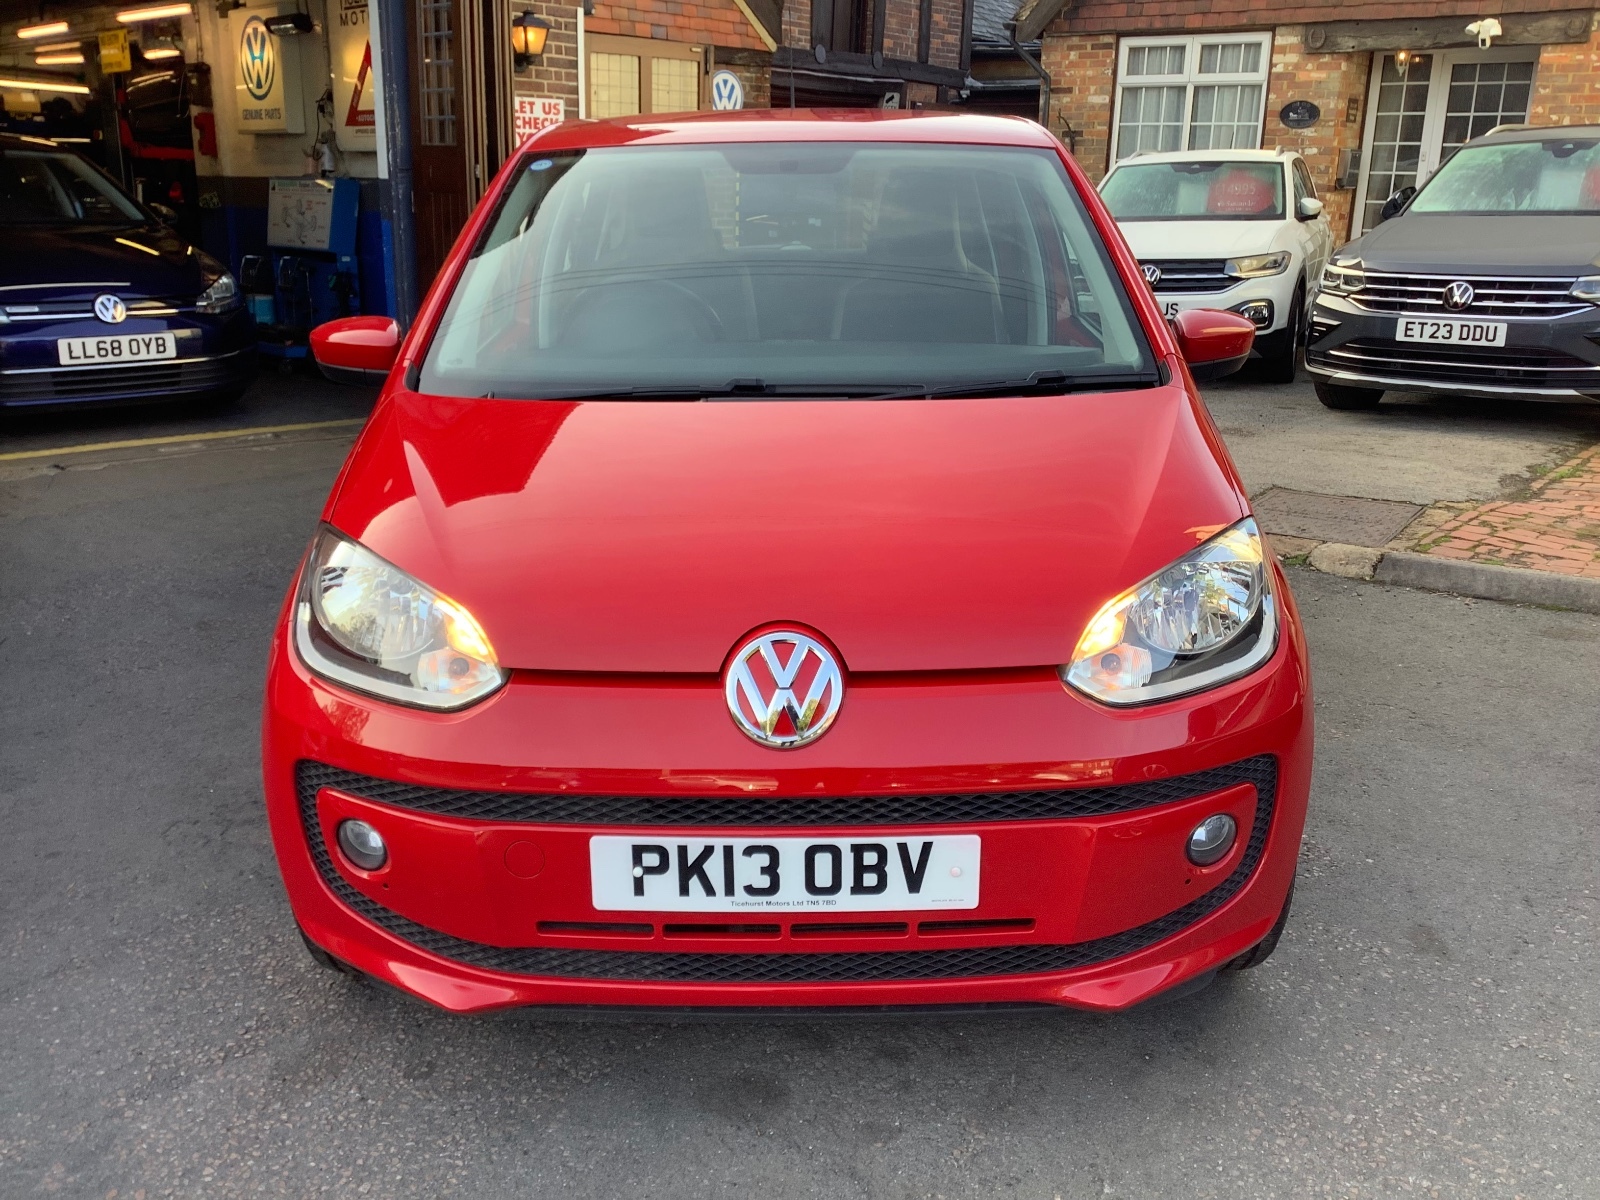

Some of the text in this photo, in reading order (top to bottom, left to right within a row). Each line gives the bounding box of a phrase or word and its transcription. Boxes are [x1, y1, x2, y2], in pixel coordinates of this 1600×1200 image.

[242, 107, 281, 120] GENUINE PARTS
[542, 102, 561, 115] US
[1404, 321, 1498, 342] ET23 DDU
[67, 337, 167, 360] LL68 OYB
[631, 841, 934, 898] PK13 OBV
